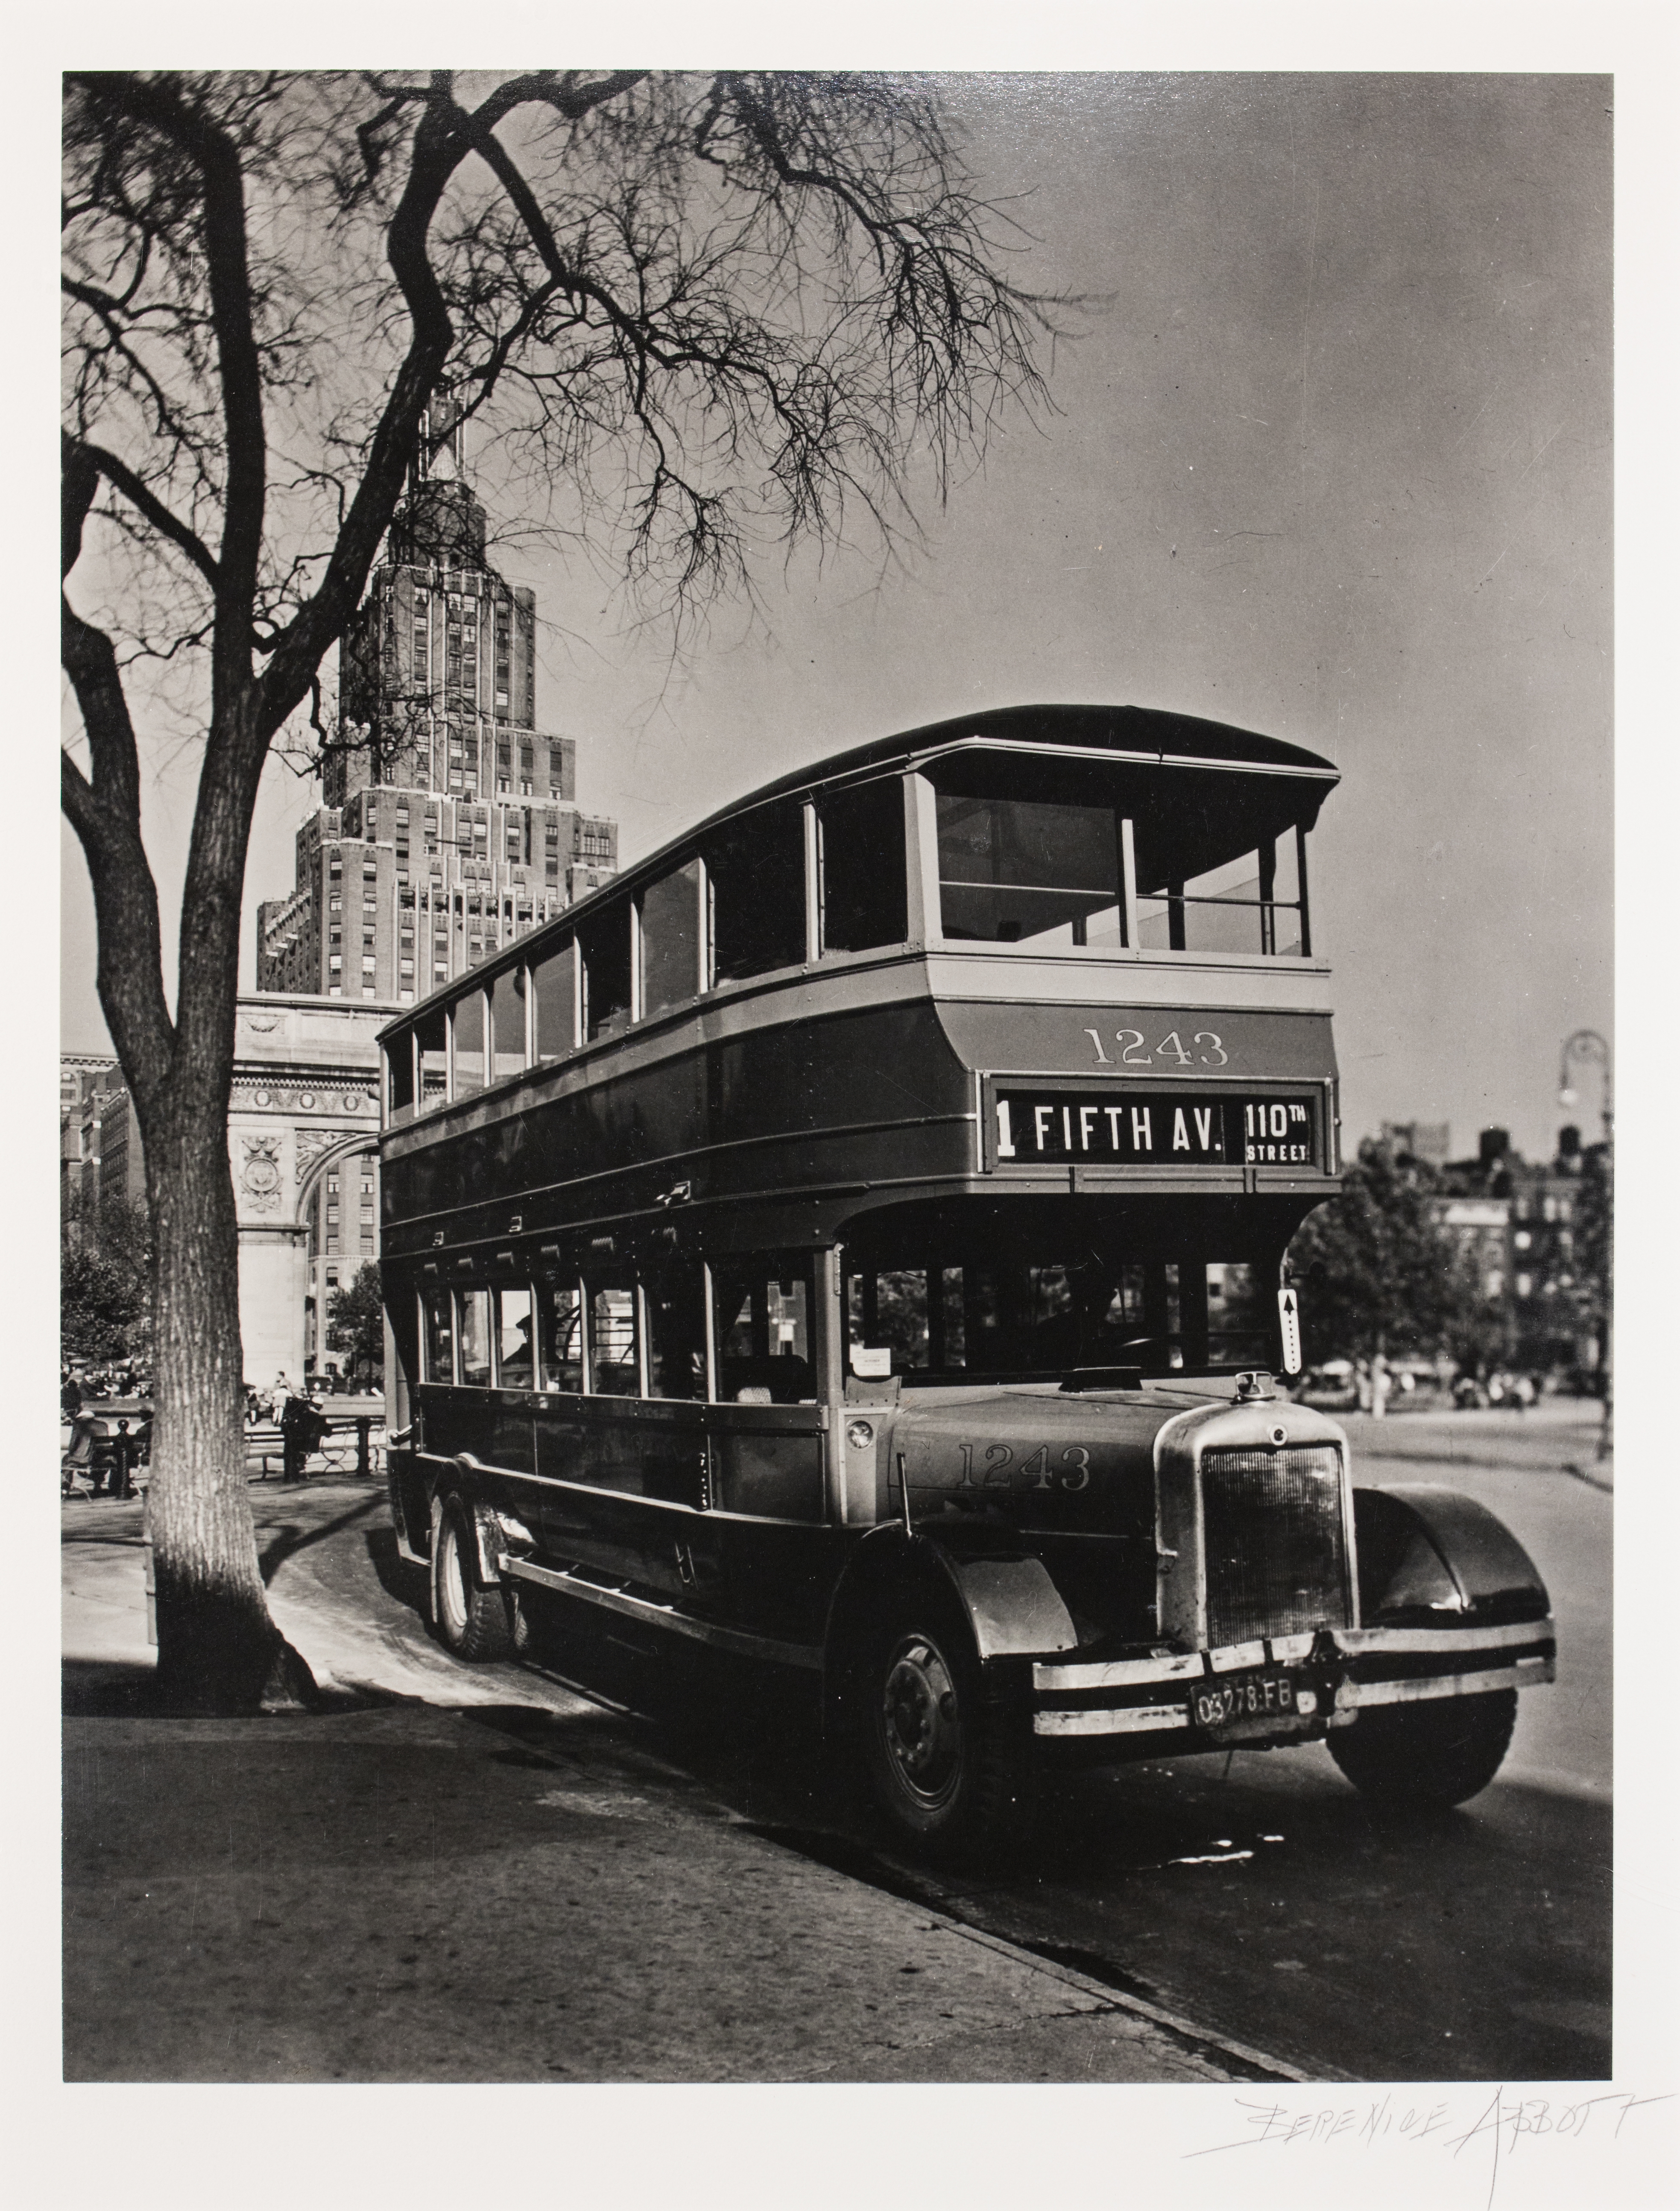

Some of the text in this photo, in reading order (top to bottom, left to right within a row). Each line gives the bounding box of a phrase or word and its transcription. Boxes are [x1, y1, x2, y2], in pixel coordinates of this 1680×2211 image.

[1083, 1028, 1228, 1066] 1243
[996, 1100, 1221, 1156] 1 FIFTH AV.
[1247, 1145, 1306, 1161] STREET
[956, 1444, 1090, 1491] 1243
